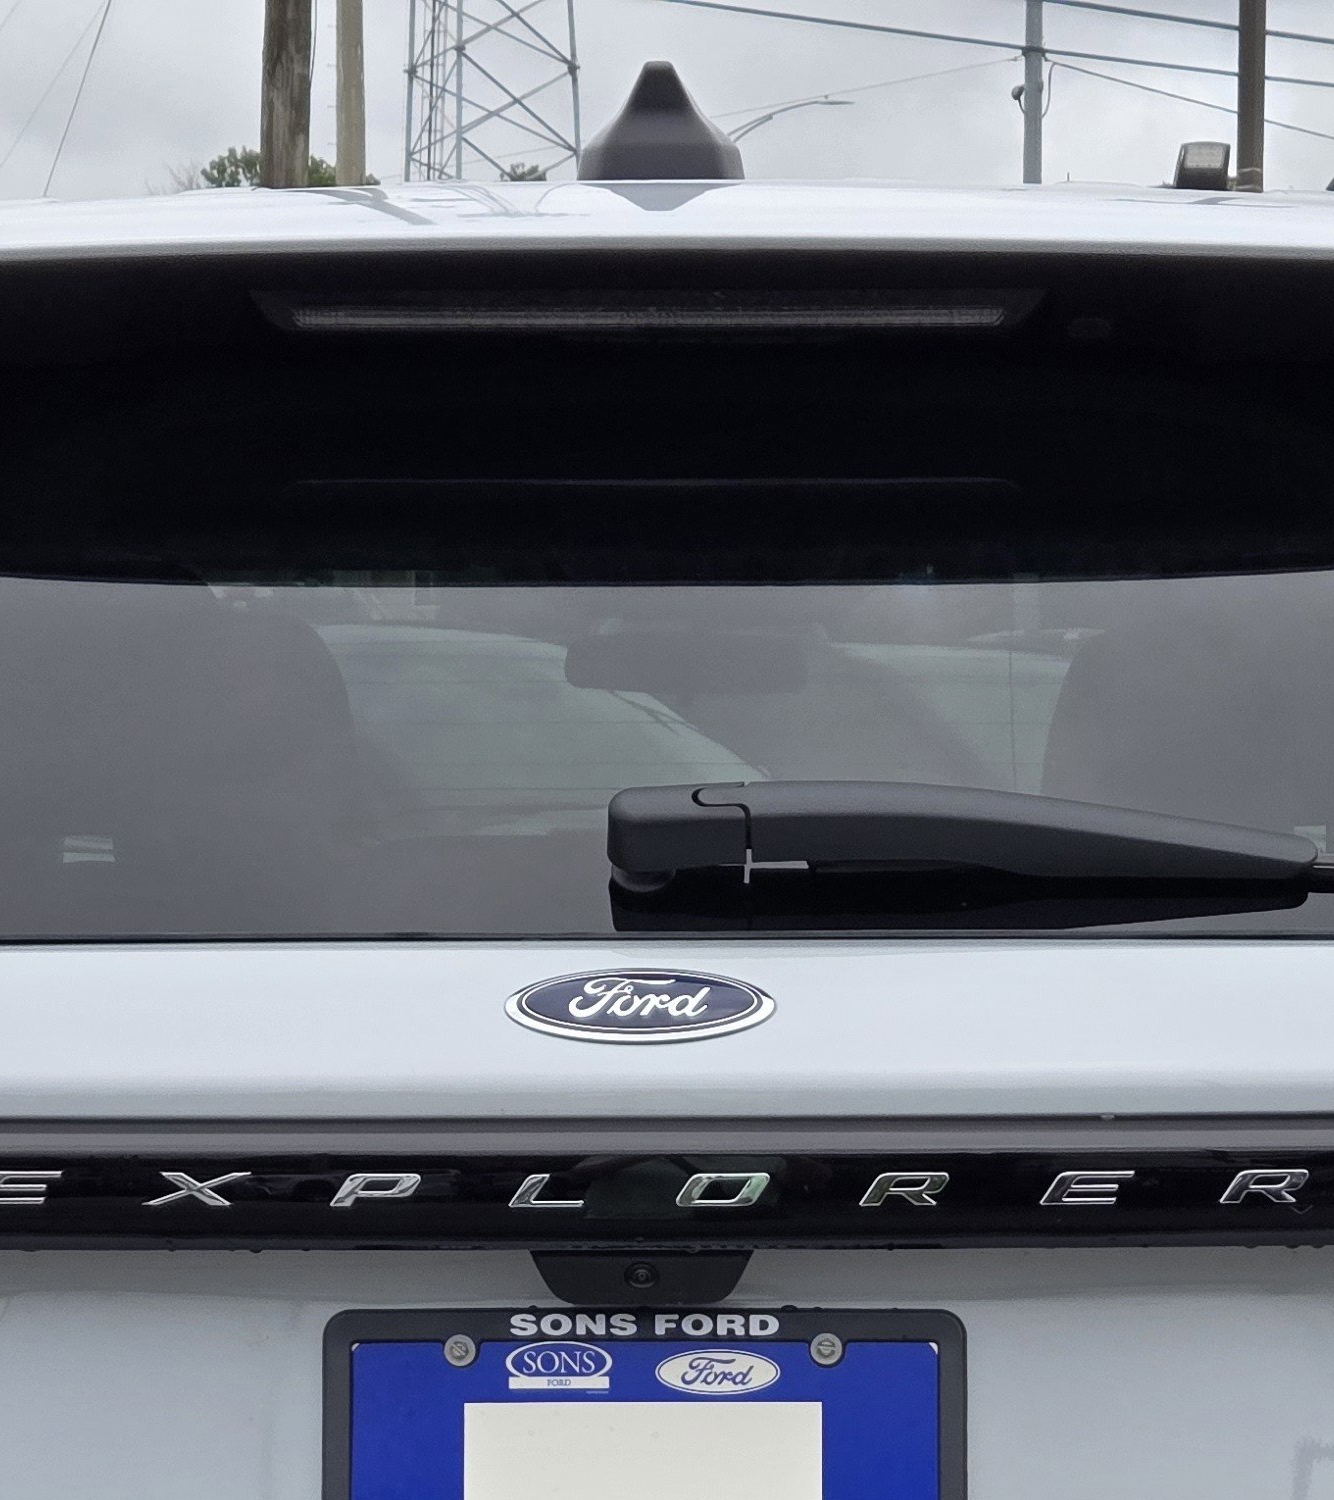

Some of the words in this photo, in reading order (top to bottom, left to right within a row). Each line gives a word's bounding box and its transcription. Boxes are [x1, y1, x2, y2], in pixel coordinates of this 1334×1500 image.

[568, 977, 710, 1018] Ford
[510, 1314, 637, 1336] SONS
[655, 1314, 779, 1336] FORD
[523, 1350, 596, 1374] SONS
[681, 1356, 753, 1386] Ford
[547, 1378, 572, 1387] FORD
